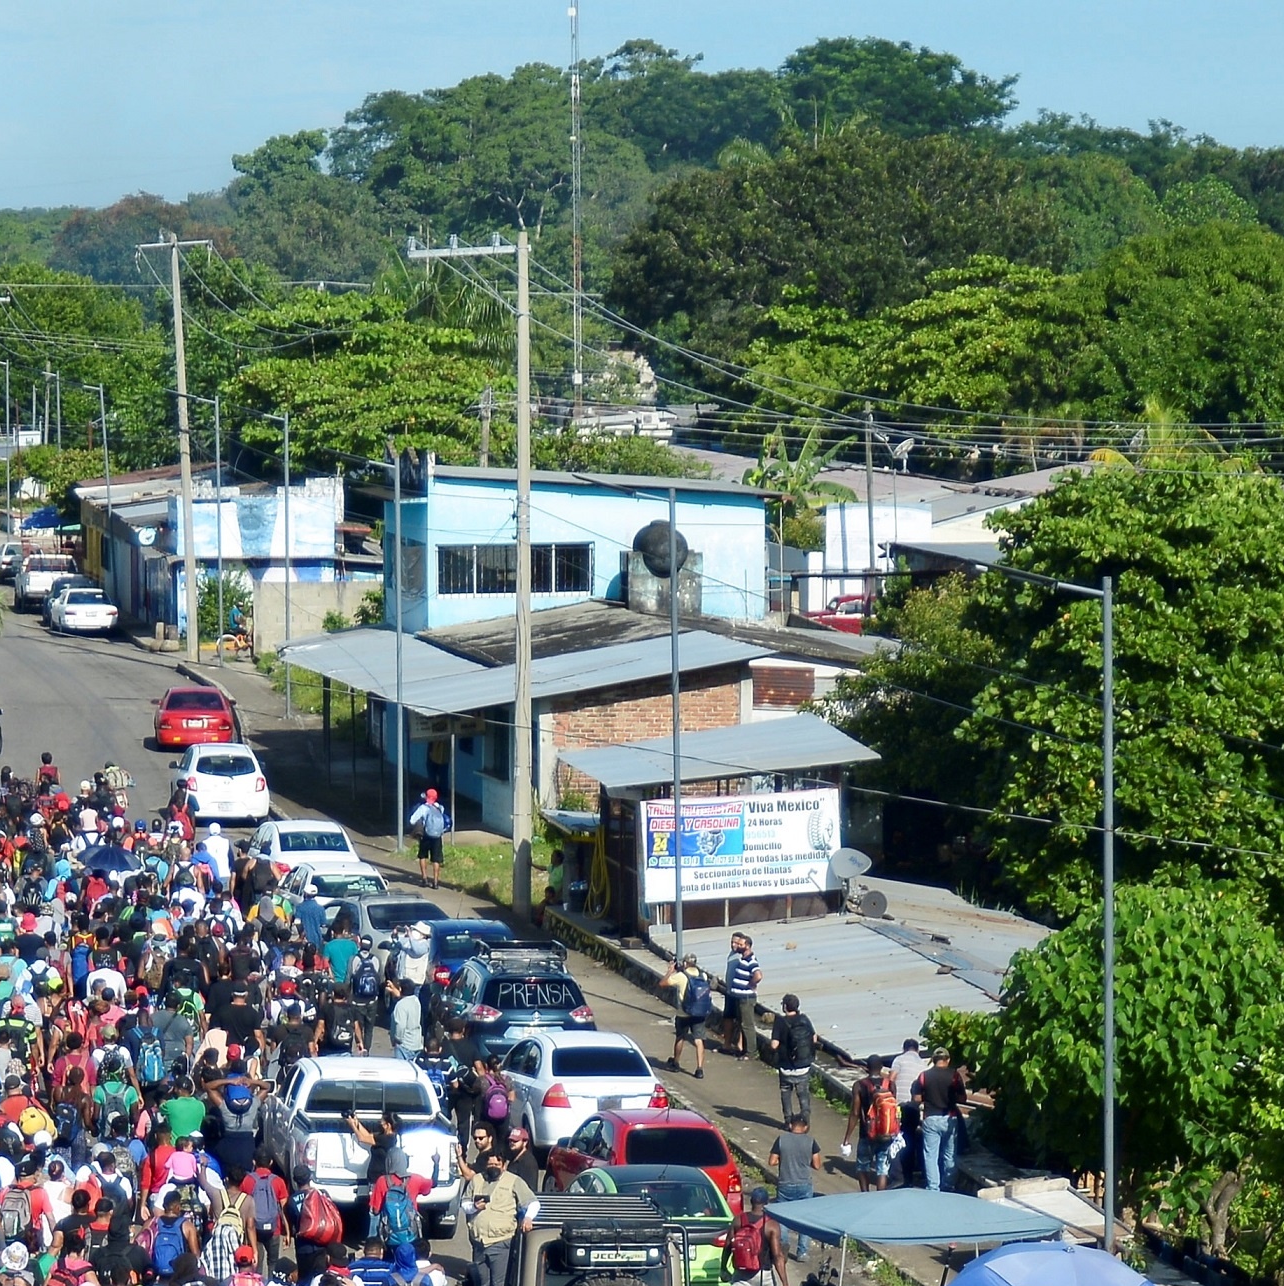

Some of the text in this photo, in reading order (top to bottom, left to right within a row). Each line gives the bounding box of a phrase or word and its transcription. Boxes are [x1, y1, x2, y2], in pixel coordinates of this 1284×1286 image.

[651, 817, 739, 830] DIESE Y GASOLINA
[748, 818, 783, 827] 24 Horas
[654, 838, 668, 852] 24
[743, 842, 782, 852] Domicilio
[756, 854, 779, 863] todas
[781, 852, 794, 861] las
[693, 865, 792, 879] Seccionadora de llantas
[679, 882, 700, 892] enta
[701, 882, 711, 891] de
[713, 880, 741, 890] llantas
[743, 879, 772, 888] Nuevas
[498, 982, 576, 1007] PRENSA
